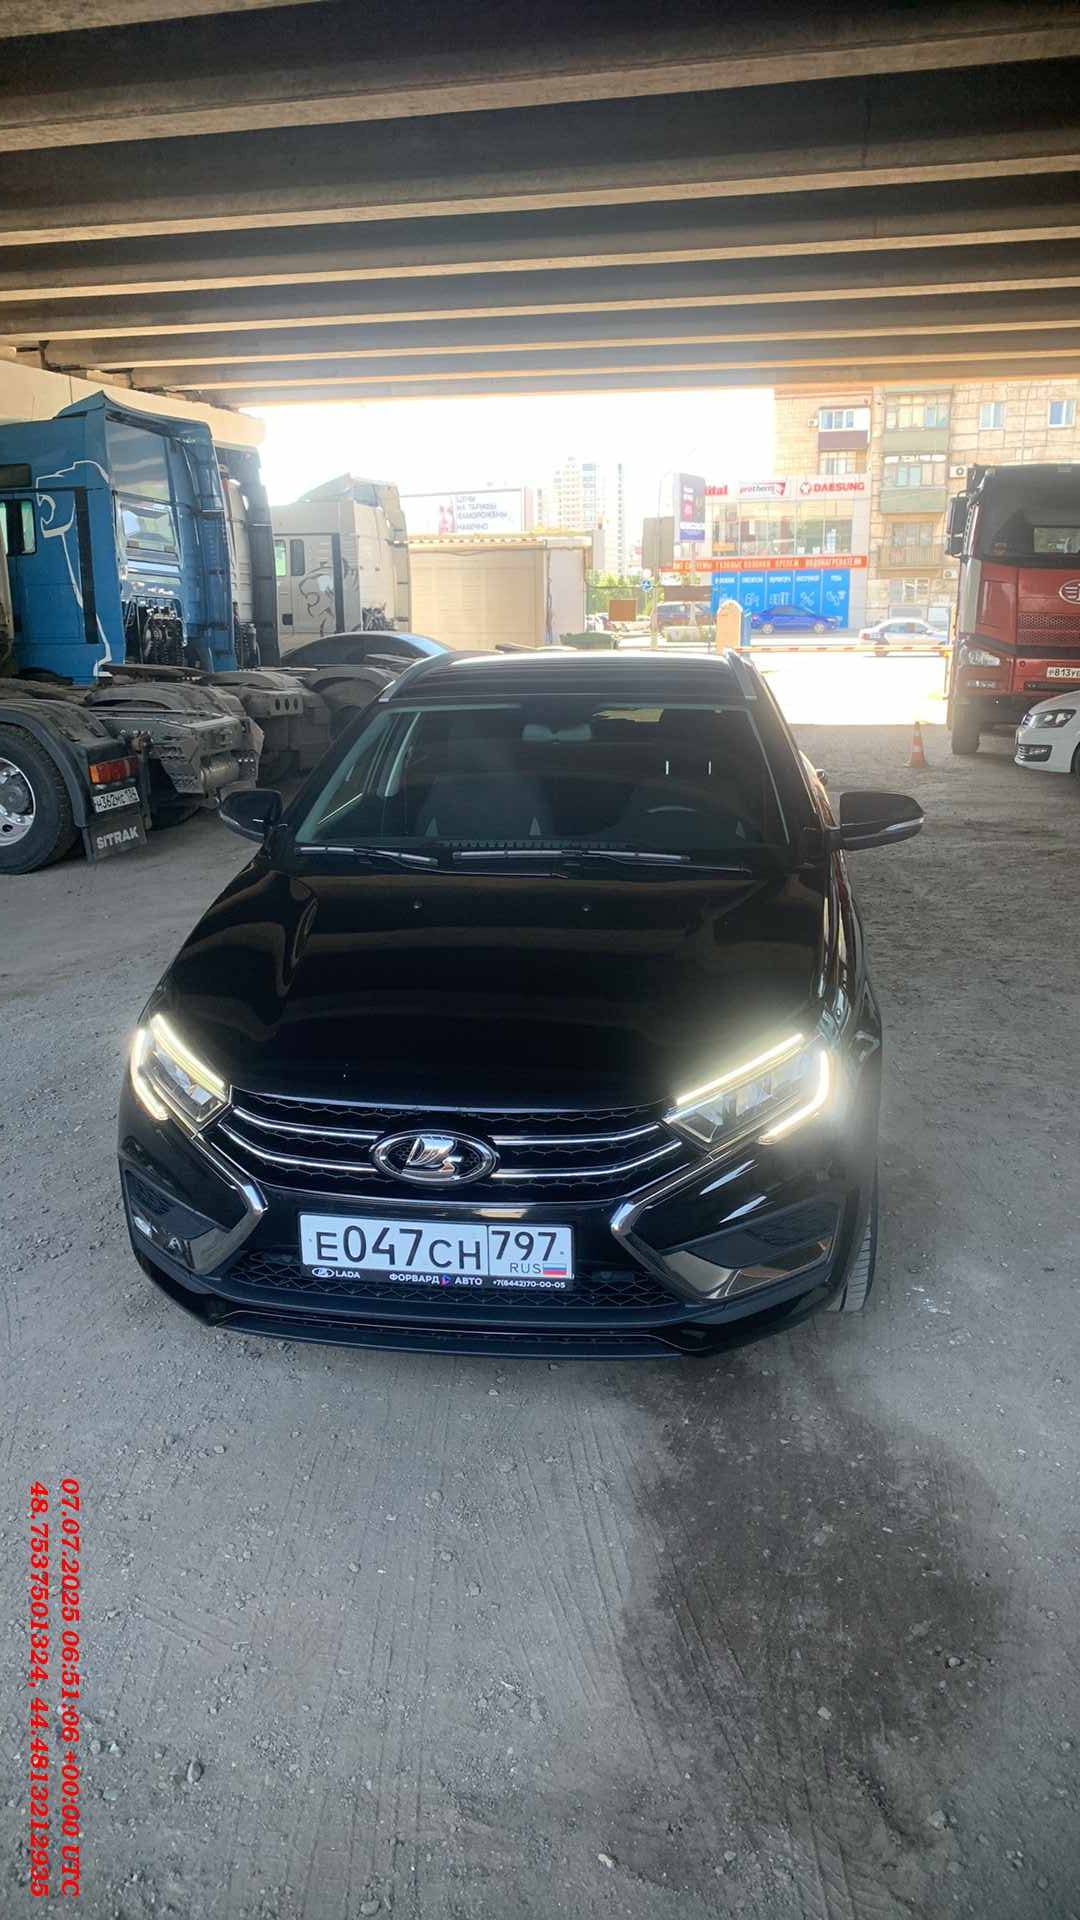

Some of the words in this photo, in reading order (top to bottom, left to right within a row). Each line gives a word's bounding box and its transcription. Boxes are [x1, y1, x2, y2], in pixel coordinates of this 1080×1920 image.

[813, 482, 865, 492] DAESUNG
[96, 826, 139, 849] SITRAK
[491, 1230, 557, 1261] 797
[509, 1262, 542, 1274] RUS
[335, 1270, 361, 1279] LADA
[389, 1273, 440, 1285] ФОРВАРД
[454, 1276, 483, 1286] АВТО
